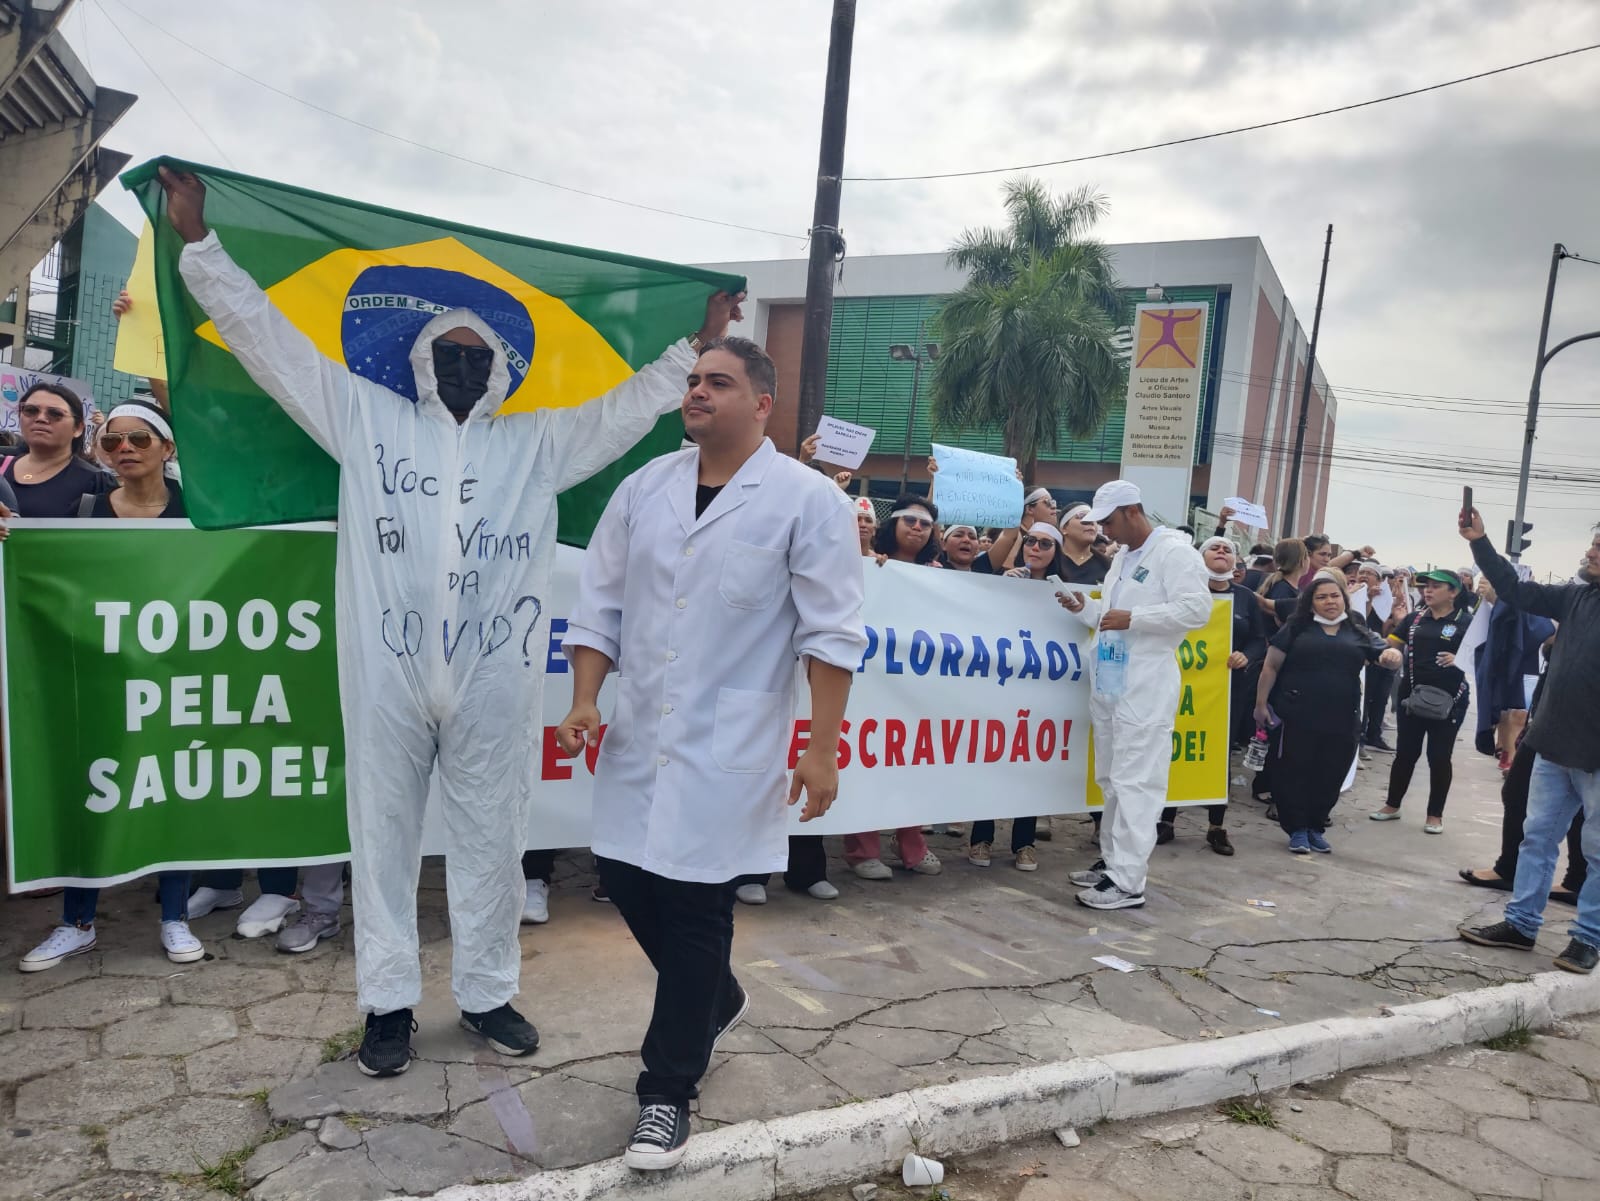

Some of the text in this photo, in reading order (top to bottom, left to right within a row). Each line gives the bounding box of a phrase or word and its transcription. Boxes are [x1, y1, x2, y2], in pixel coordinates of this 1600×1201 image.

[349, 296, 426, 310] ORDEM E
[375, 516, 405, 554] FOI
[448, 570, 479, 595] DA
[95, 598, 322, 654] TODOS
[382, 595, 542, 667] COVID?
[856, 625, 1083, 687] PLORAÇÃO!
[125, 674, 292, 732] PELA
[1171, 731, 1206, 762] DE!
[84, 739, 330, 814] SAÚDE!
